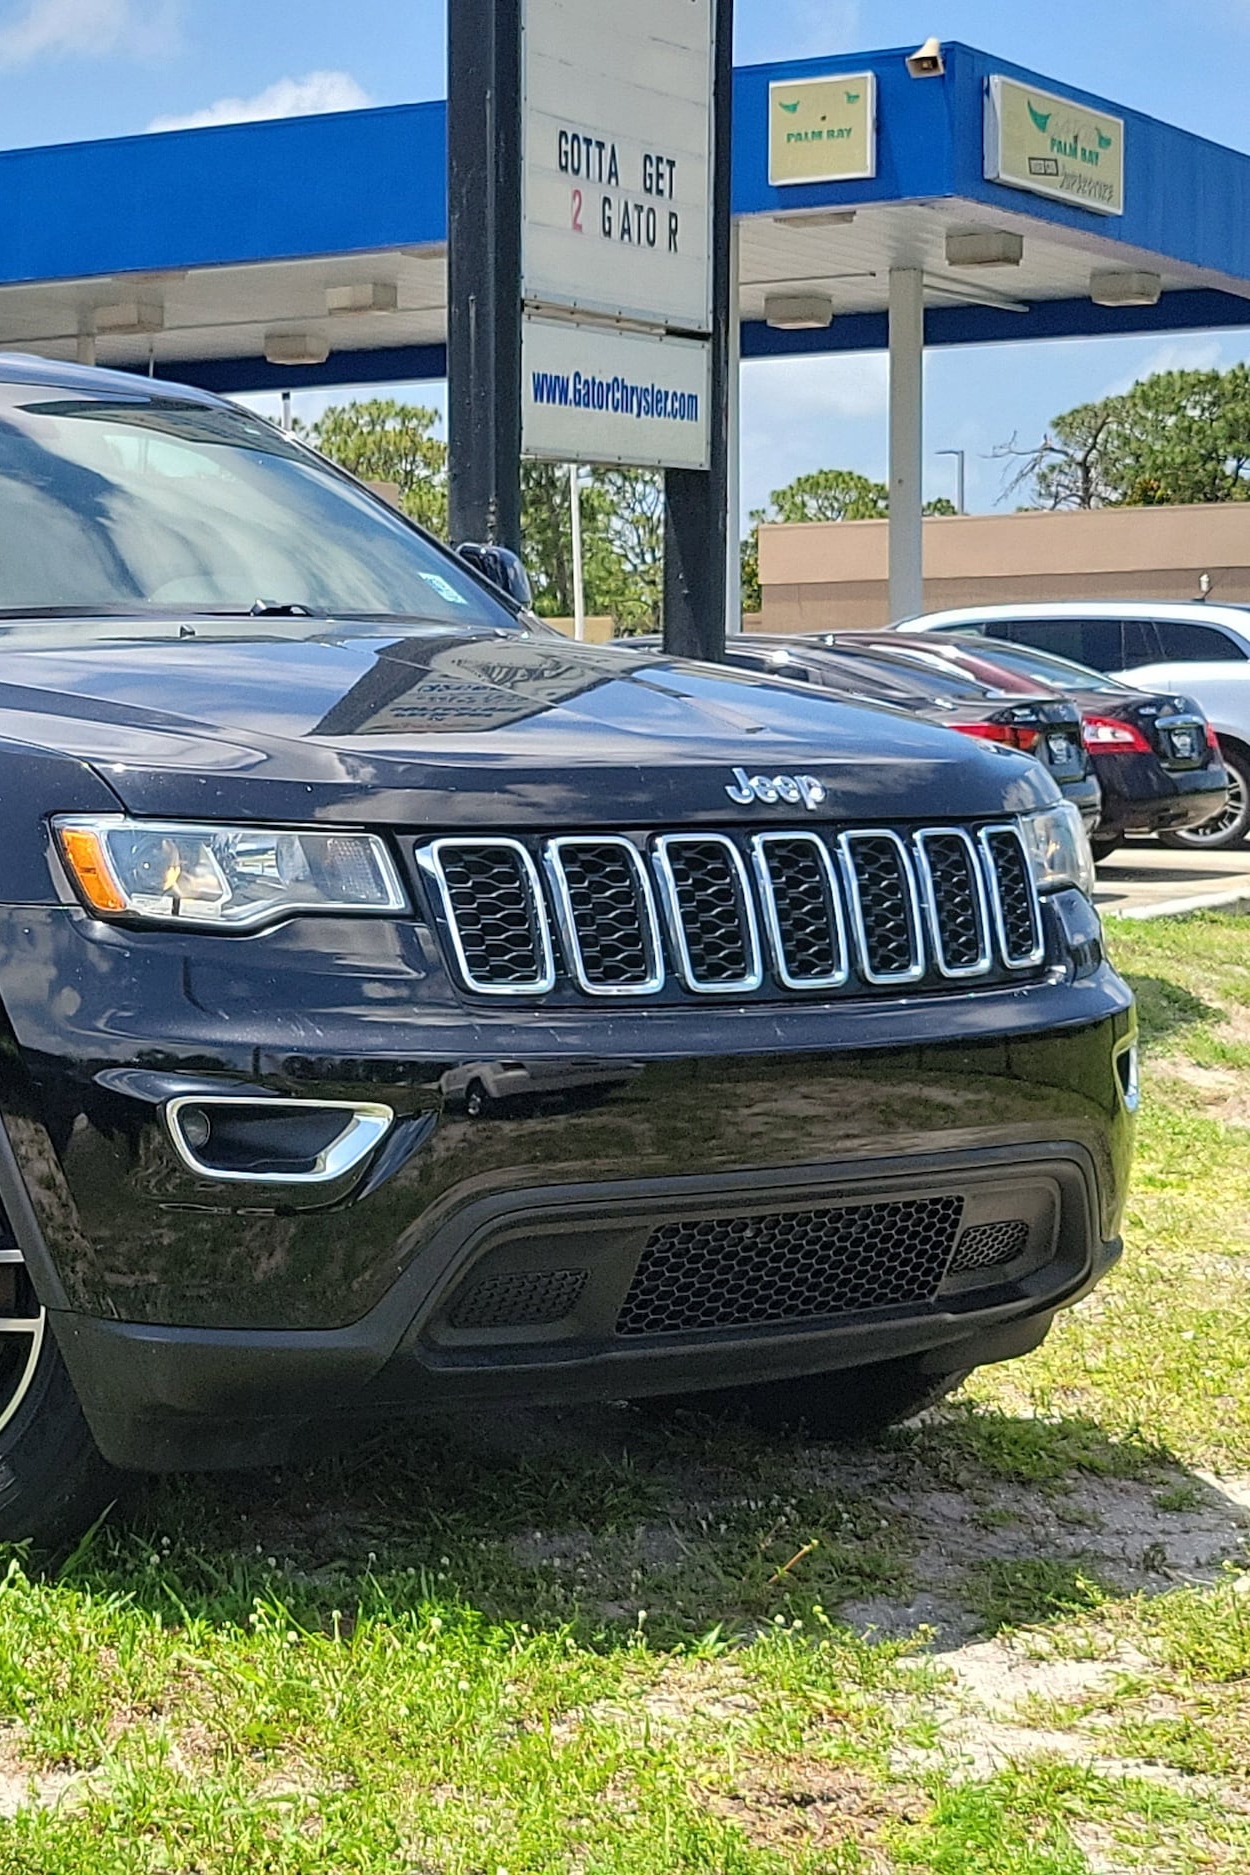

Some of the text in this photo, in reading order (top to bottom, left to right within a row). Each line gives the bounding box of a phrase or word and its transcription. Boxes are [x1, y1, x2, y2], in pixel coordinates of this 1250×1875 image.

[786, 127, 853, 144] PALM BAY
[1050, 137, 1078, 161] PALM
[557, 130, 677, 200] GOTTA GET
[571, 188, 583, 233] 2
[532, 369, 699, 423] www.GatorChrysler.com
[724, 767, 827, 811] Jeep
